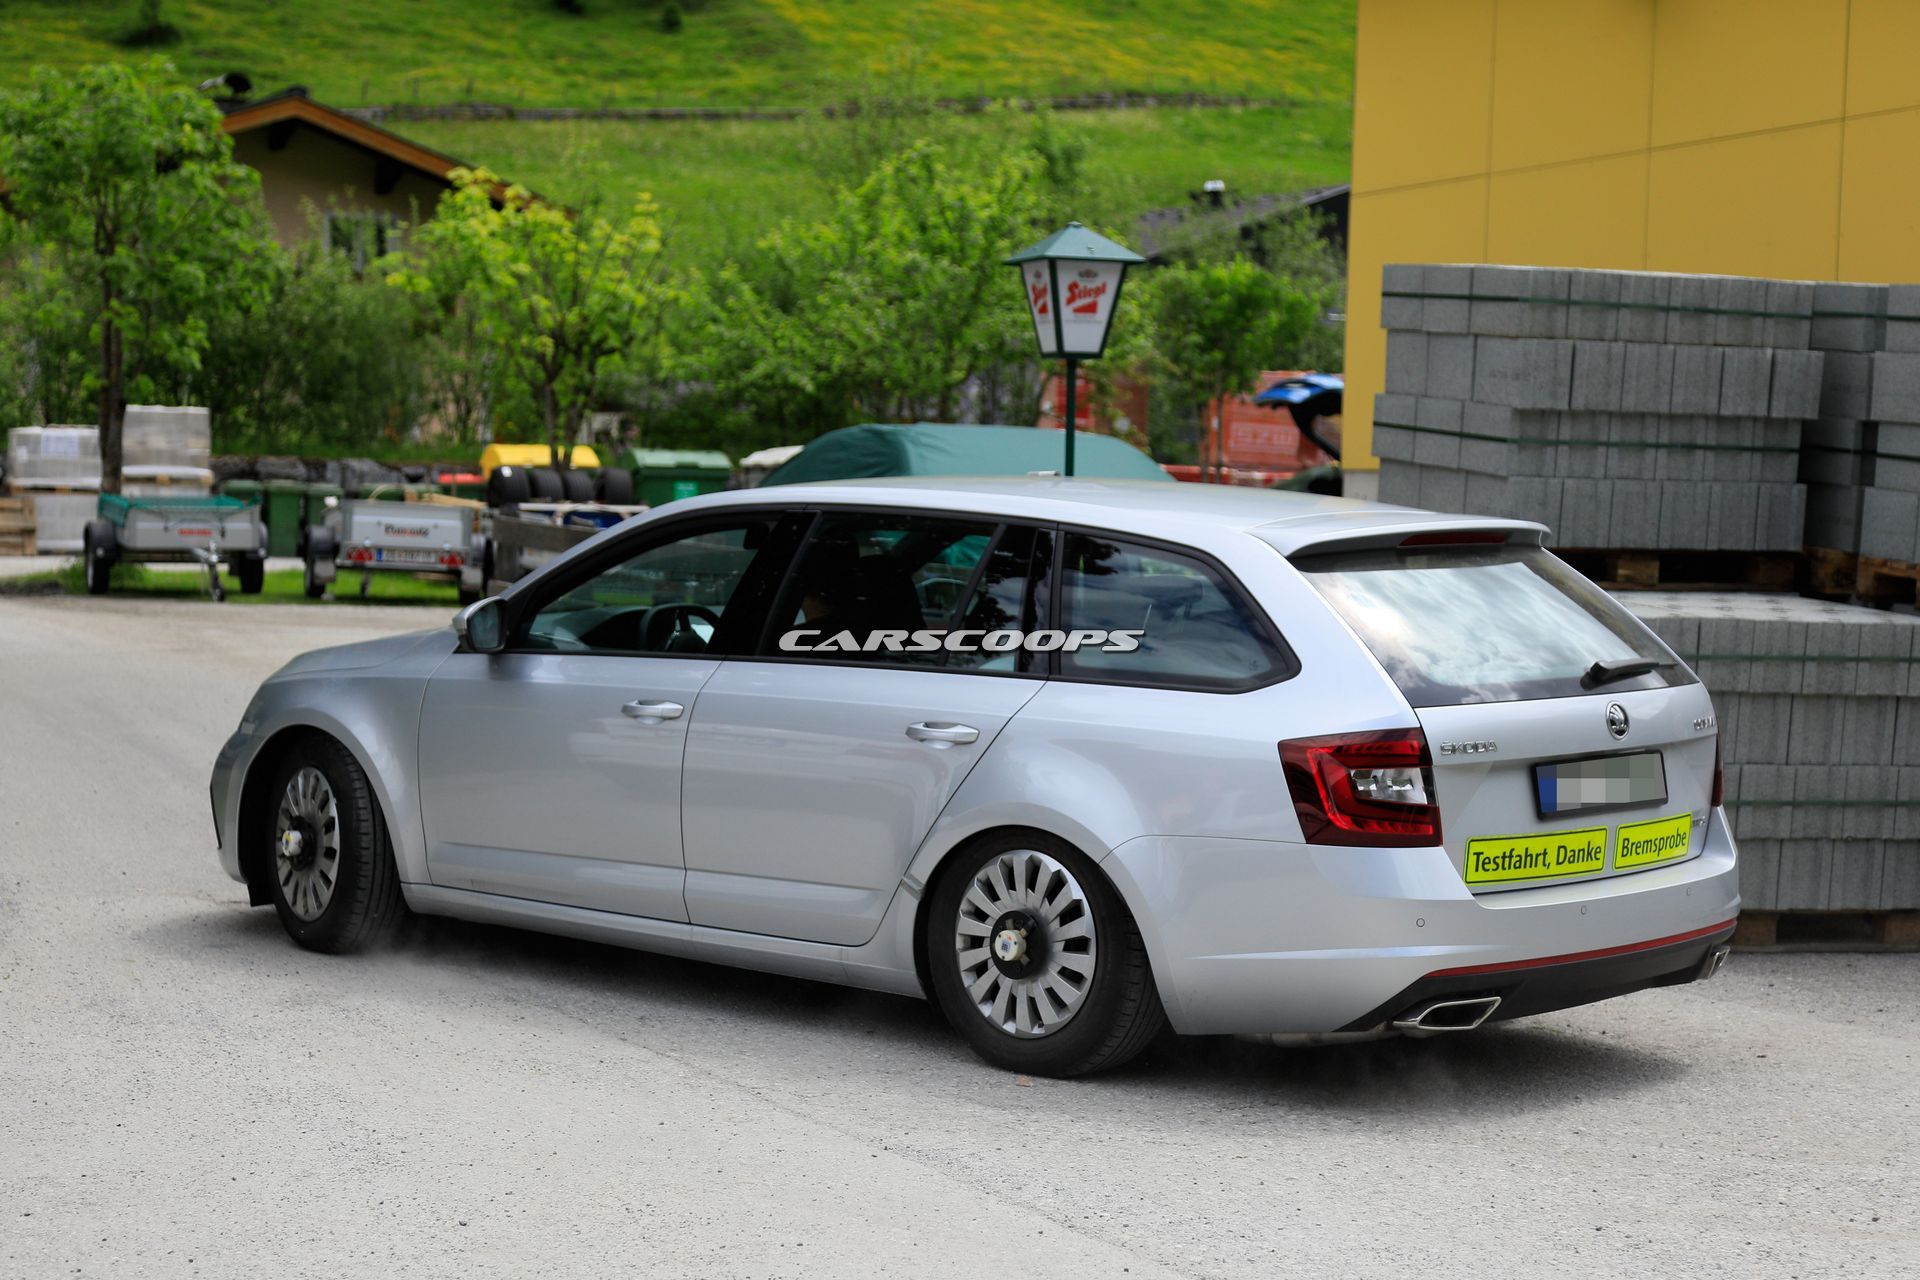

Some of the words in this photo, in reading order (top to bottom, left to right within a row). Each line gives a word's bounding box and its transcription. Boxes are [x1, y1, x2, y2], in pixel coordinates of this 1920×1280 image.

[1473, 847, 1551, 873] Testfahrt,
[1555, 840, 1602, 866] Danke
[1621, 828, 1688, 858] Bremsprobe
